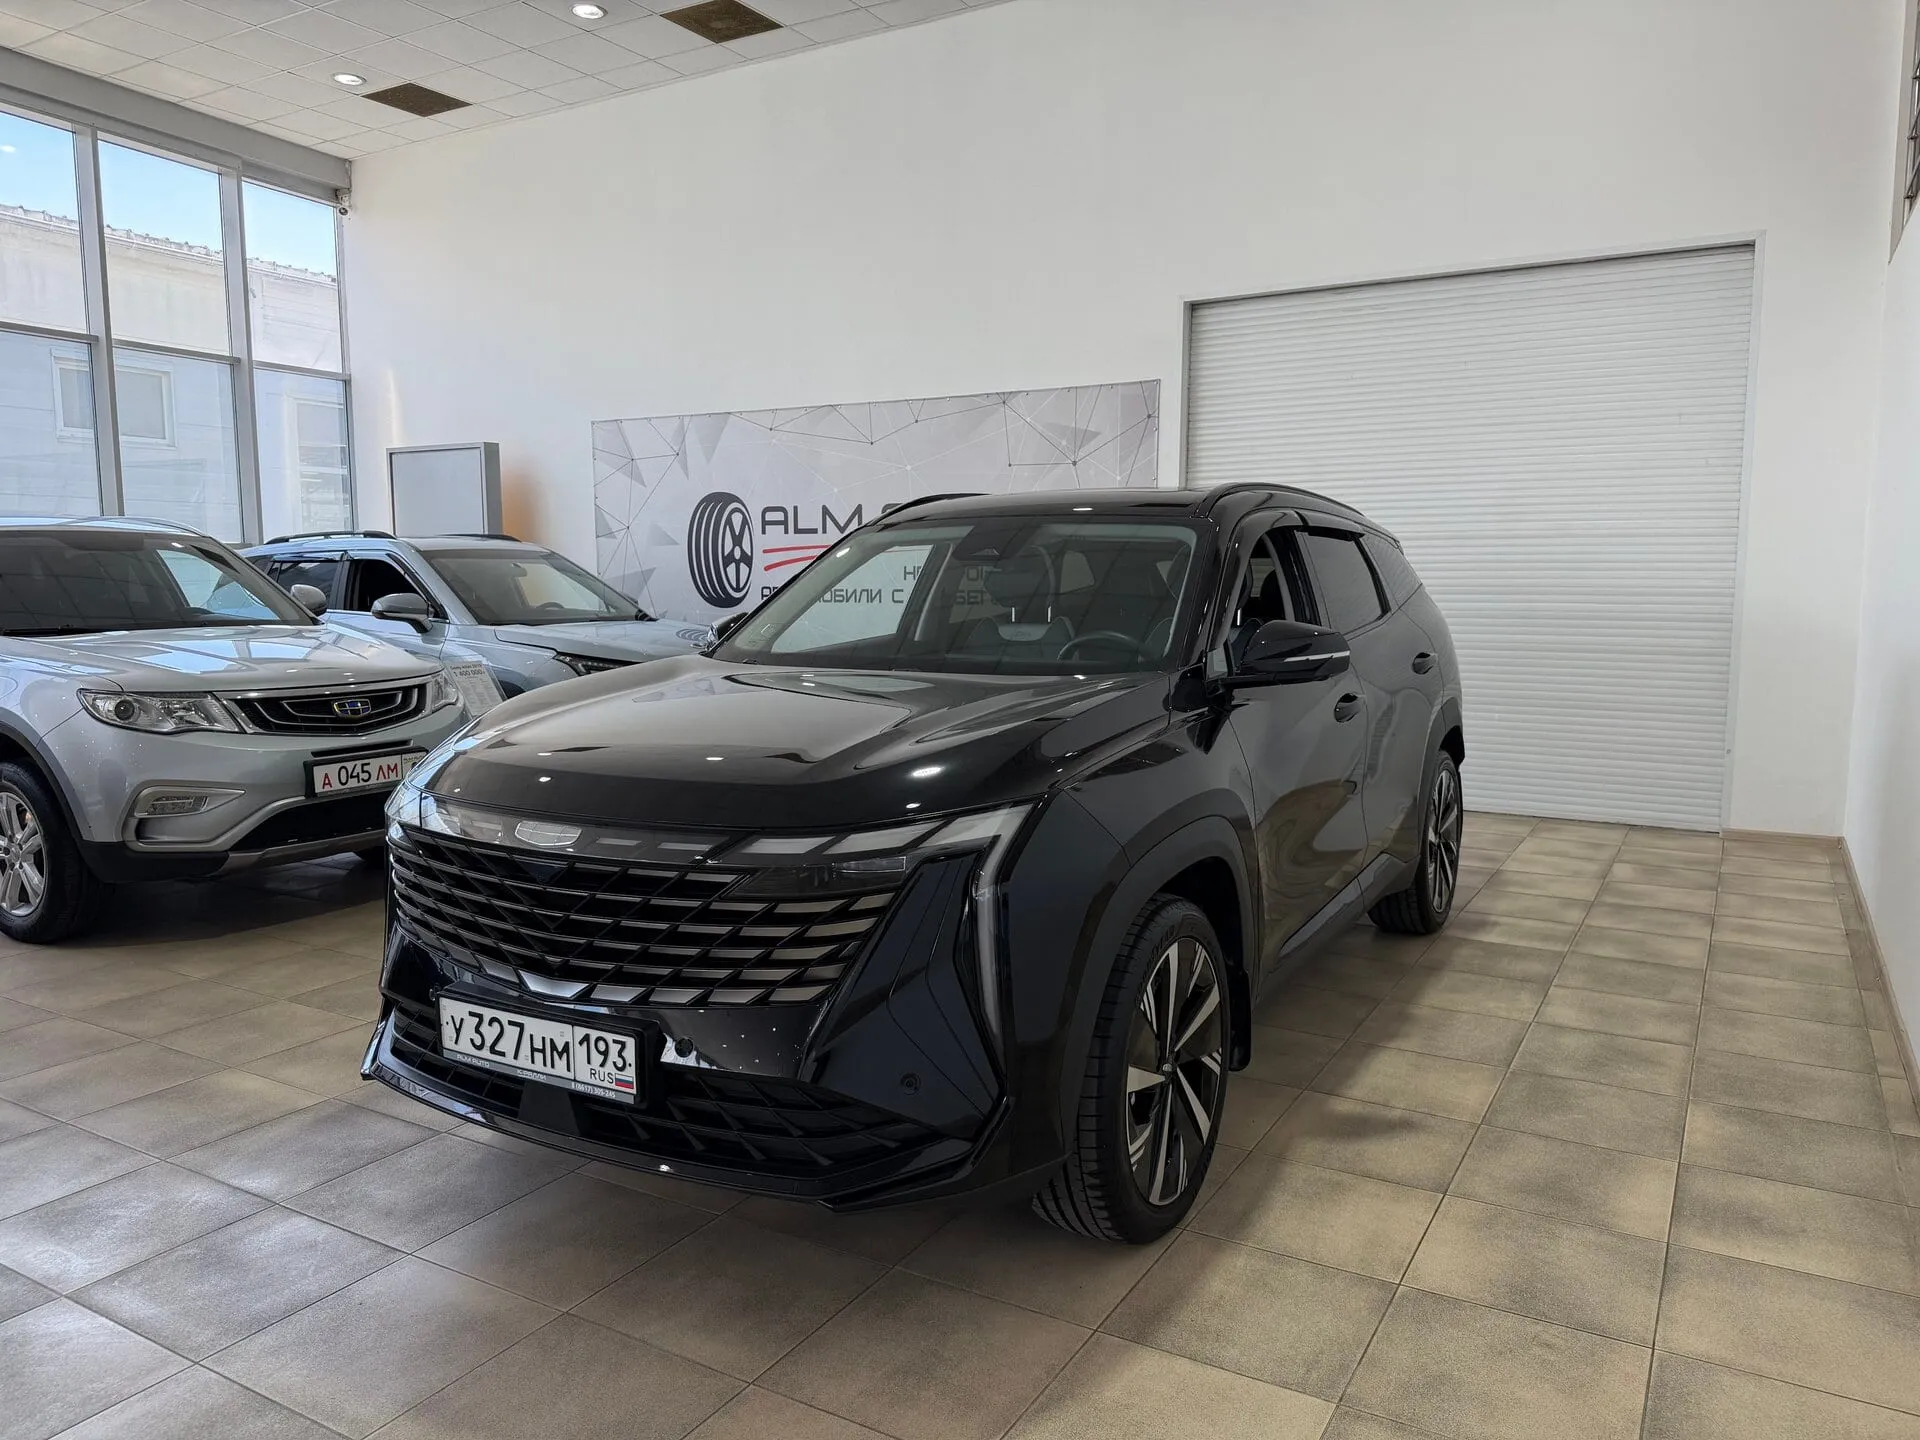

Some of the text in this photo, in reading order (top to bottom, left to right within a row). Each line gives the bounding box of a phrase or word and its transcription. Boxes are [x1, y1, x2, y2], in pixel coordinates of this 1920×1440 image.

[761, 504, 863, 535] ALM
[761, 586, 904, 604] АОБИЛИ С
[338, 763, 372, 786] 045
[578, 1033, 627, 1072] 193
[590, 1068, 614, 1084] RUS
